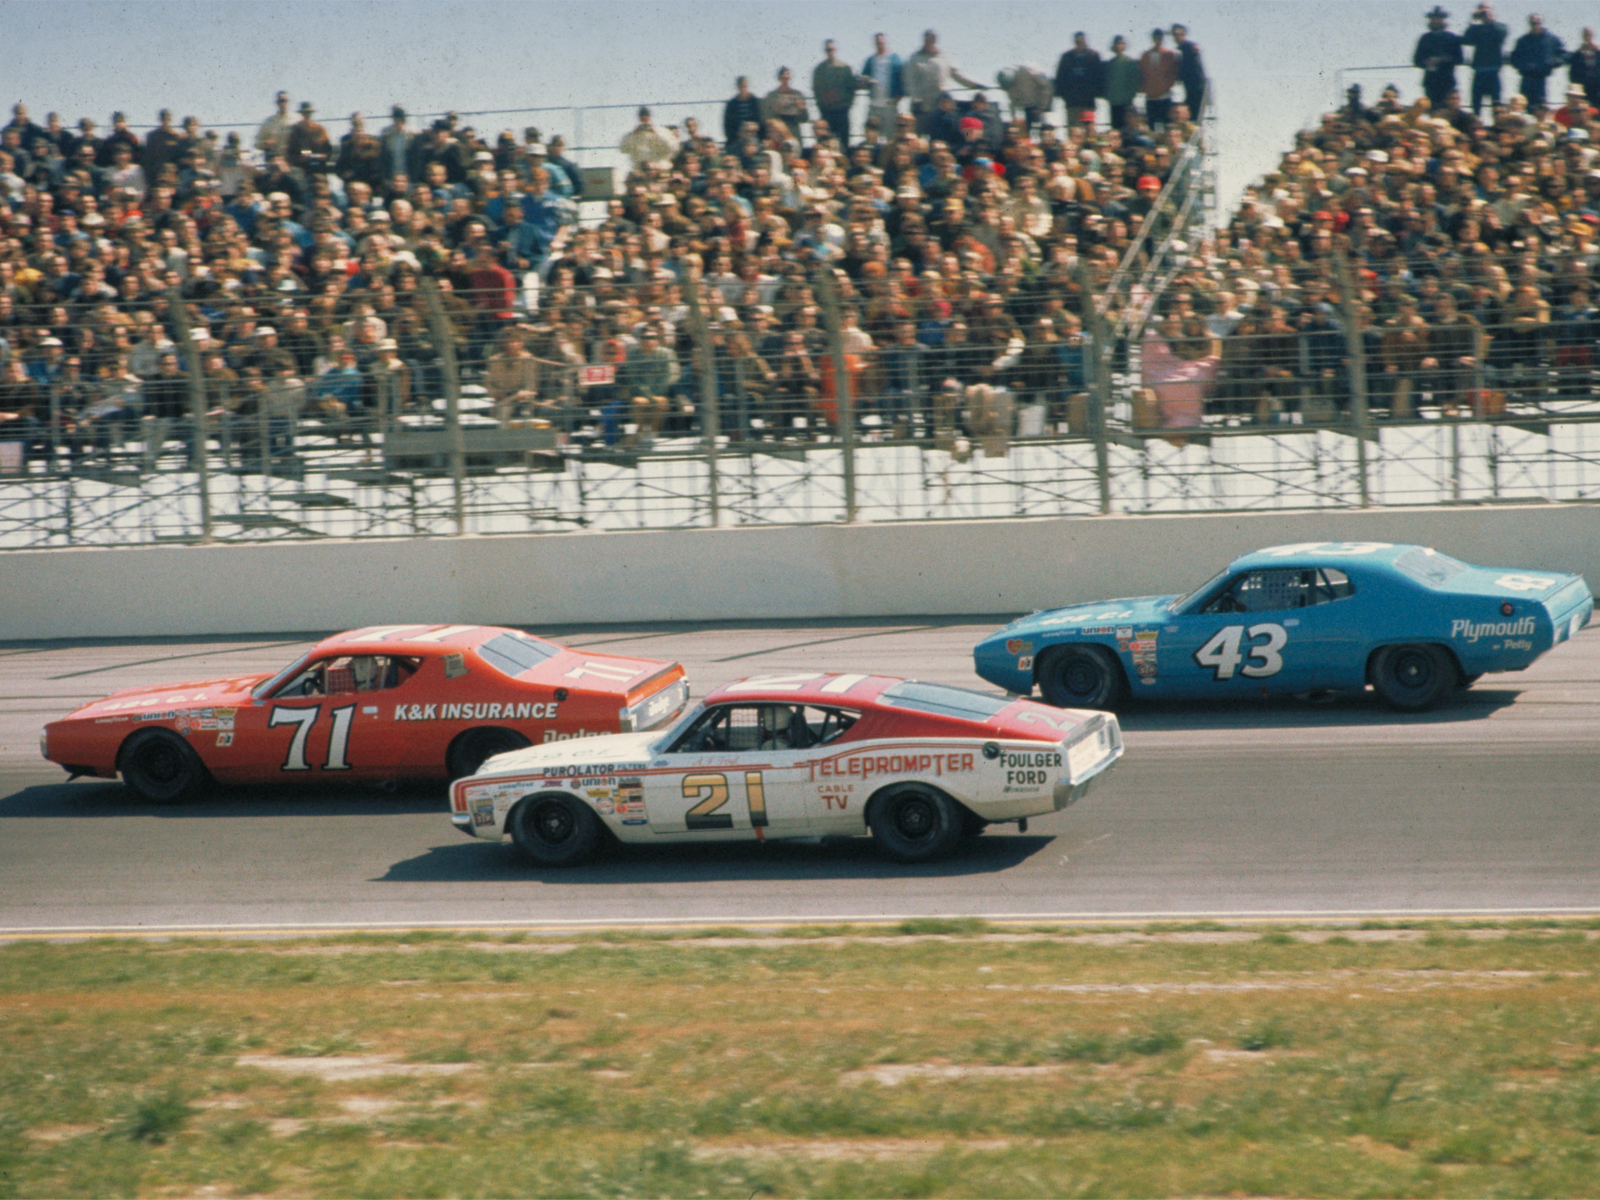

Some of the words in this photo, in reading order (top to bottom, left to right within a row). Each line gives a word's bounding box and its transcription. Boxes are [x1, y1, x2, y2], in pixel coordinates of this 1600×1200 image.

[1451, 616, 1536, 643] Plymouth
[1195, 622, 1288, 679] 43
[1504, 640, 1532, 651] Petty
[563, 661, 646, 682] 71
[394, 704, 437, 720] K&K
[441, 703, 559, 719] INSURANCE
[1015, 705, 1091, 732] 21
[268, 703, 356, 771] 71
[807, 753, 974, 781] TELEPROMPTER
[1000, 754, 1062, 767] FOULGER
[543, 764, 615, 777] PUROLATOR
[617, 763, 647, 771] FILTERS
[1007, 771, 1046, 784] FORD
[582, 777, 616, 786] union
[818, 785, 854, 793] CABLE
[682, 771, 769, 830] 21
[821, 796, 848, 810] TV
